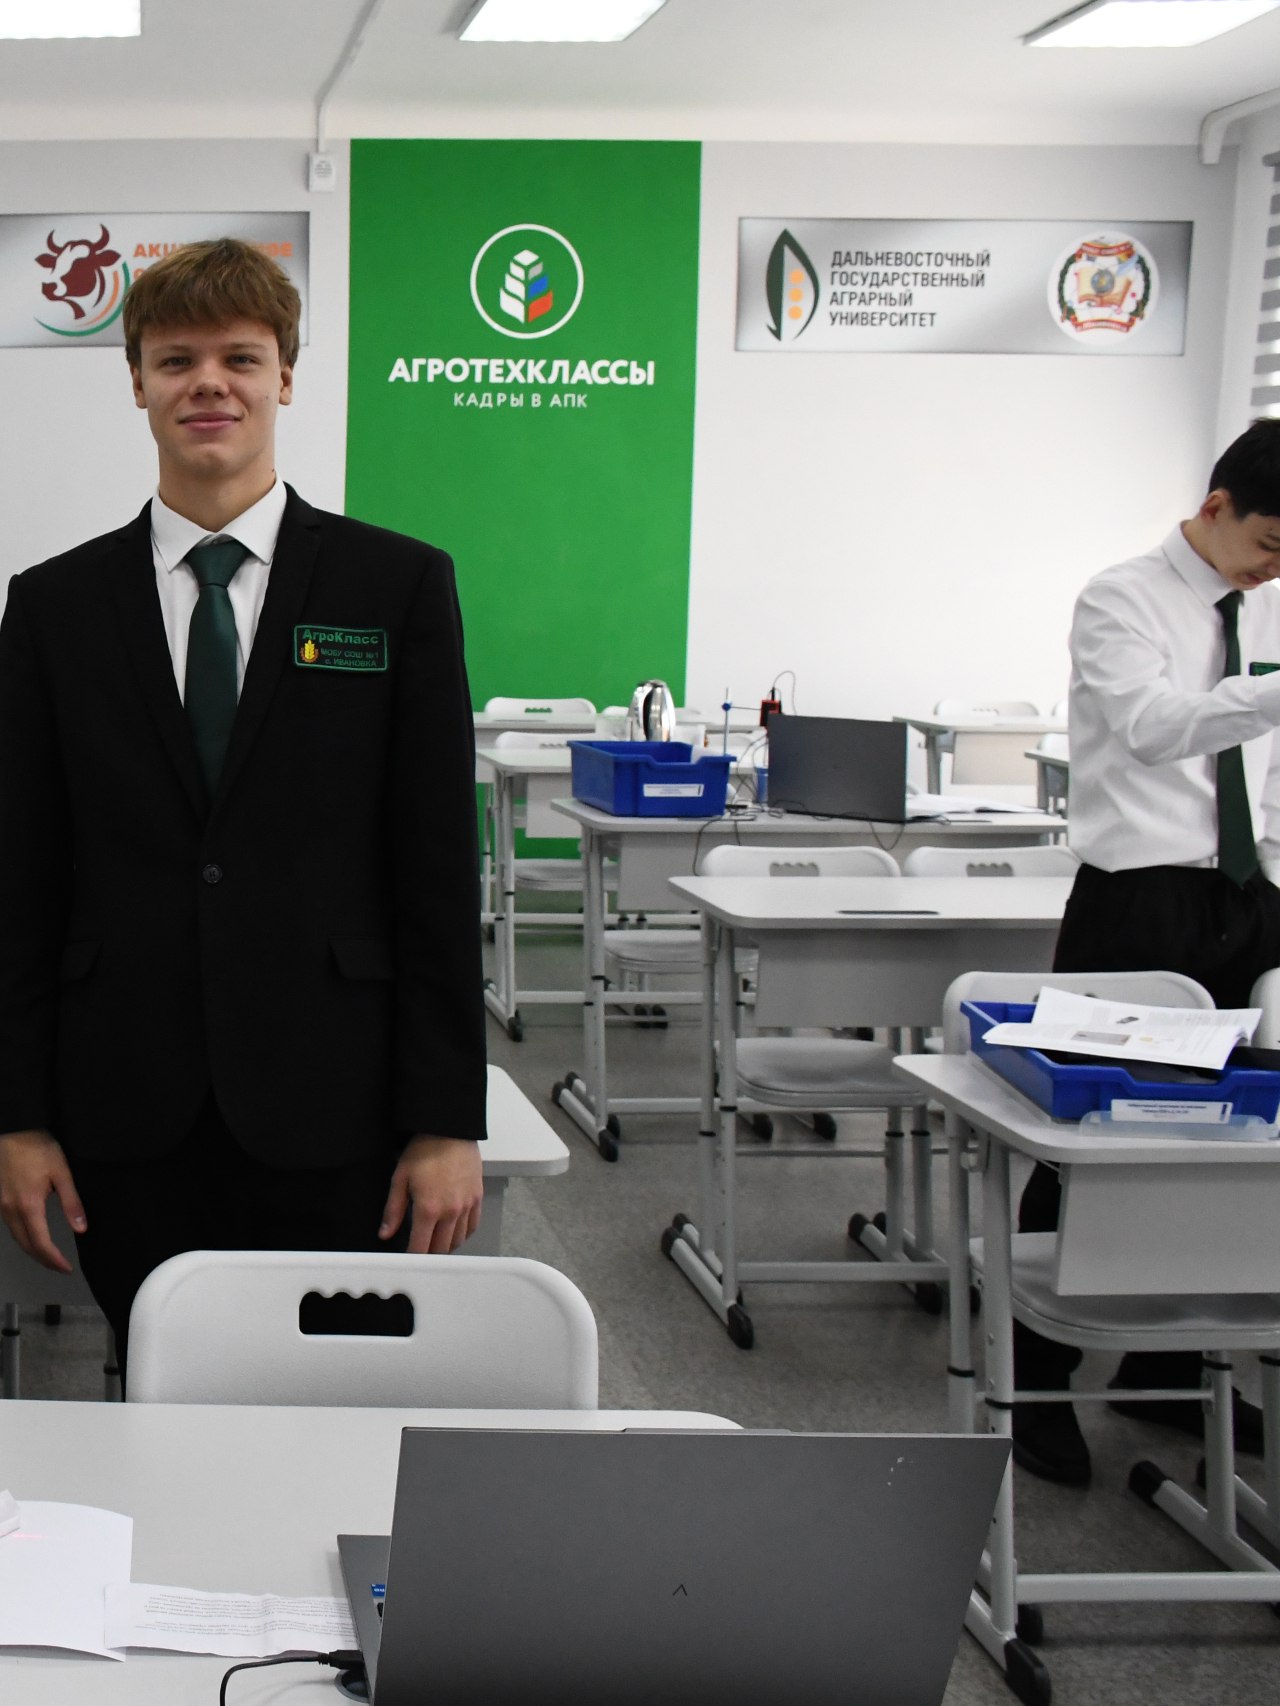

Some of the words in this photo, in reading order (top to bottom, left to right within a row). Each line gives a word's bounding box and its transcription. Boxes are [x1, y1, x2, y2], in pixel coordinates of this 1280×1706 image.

[831, 249, 991, 268] ДАЛЬНЕВОСТОЧНЫЙ
[830, 270, 986, 288] ГОСУДАРСТВЕННЫЙ
[829, 289, 913, 307] АГРАРНЫЙ
[829, 311, 937, 327] УНИВЕРСИТЕТ
[388, 357, 655, 386] АГРОТЕХКЛАССЫ
[454, 392, 524, 409] КАДРЫ
[531, 393, 542, 408] В
[549, 393, 588, 408] АПК
[303, 628, 379, 644] АгроКласс
